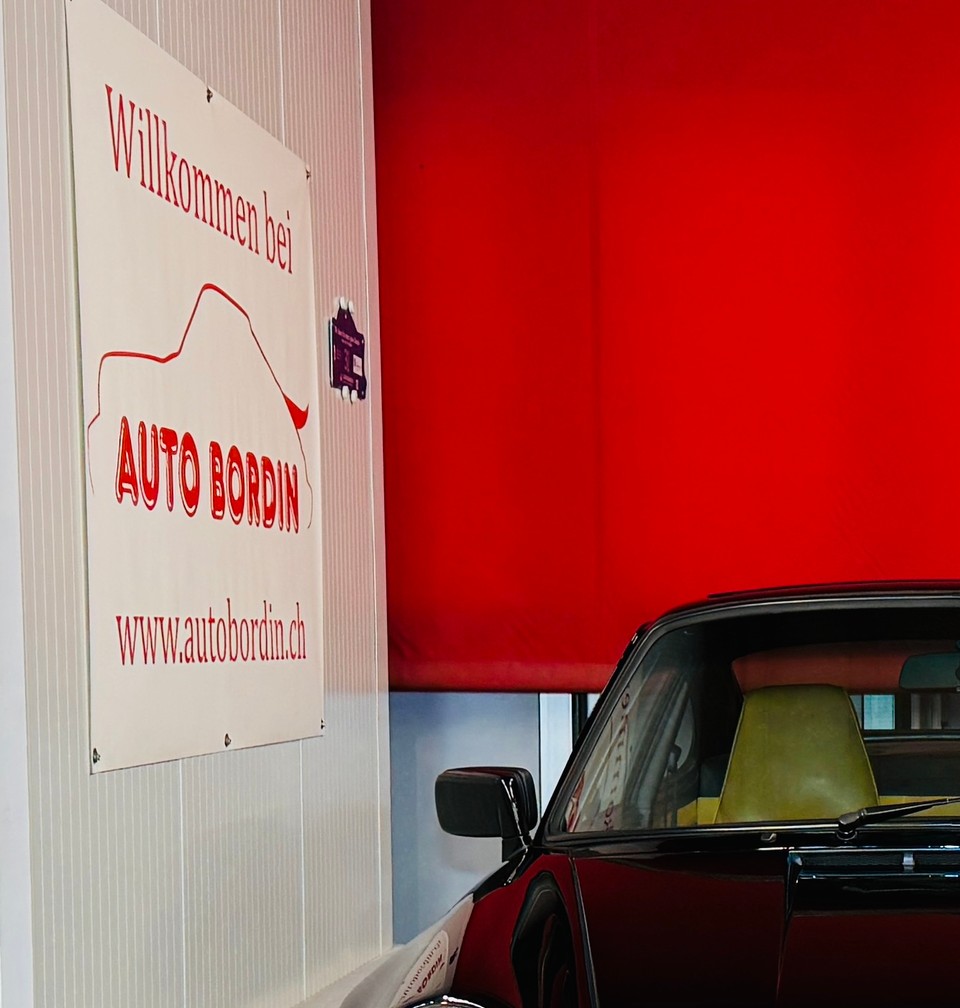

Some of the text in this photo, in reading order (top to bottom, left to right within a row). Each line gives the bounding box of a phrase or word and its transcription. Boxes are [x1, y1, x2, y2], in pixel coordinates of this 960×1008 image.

[104, 83, 294, 275] Willkommen bei
[114, 415, 300, 535] AUTO BORDIN
[115, 597, 307, 667] www.autobordin.ch
